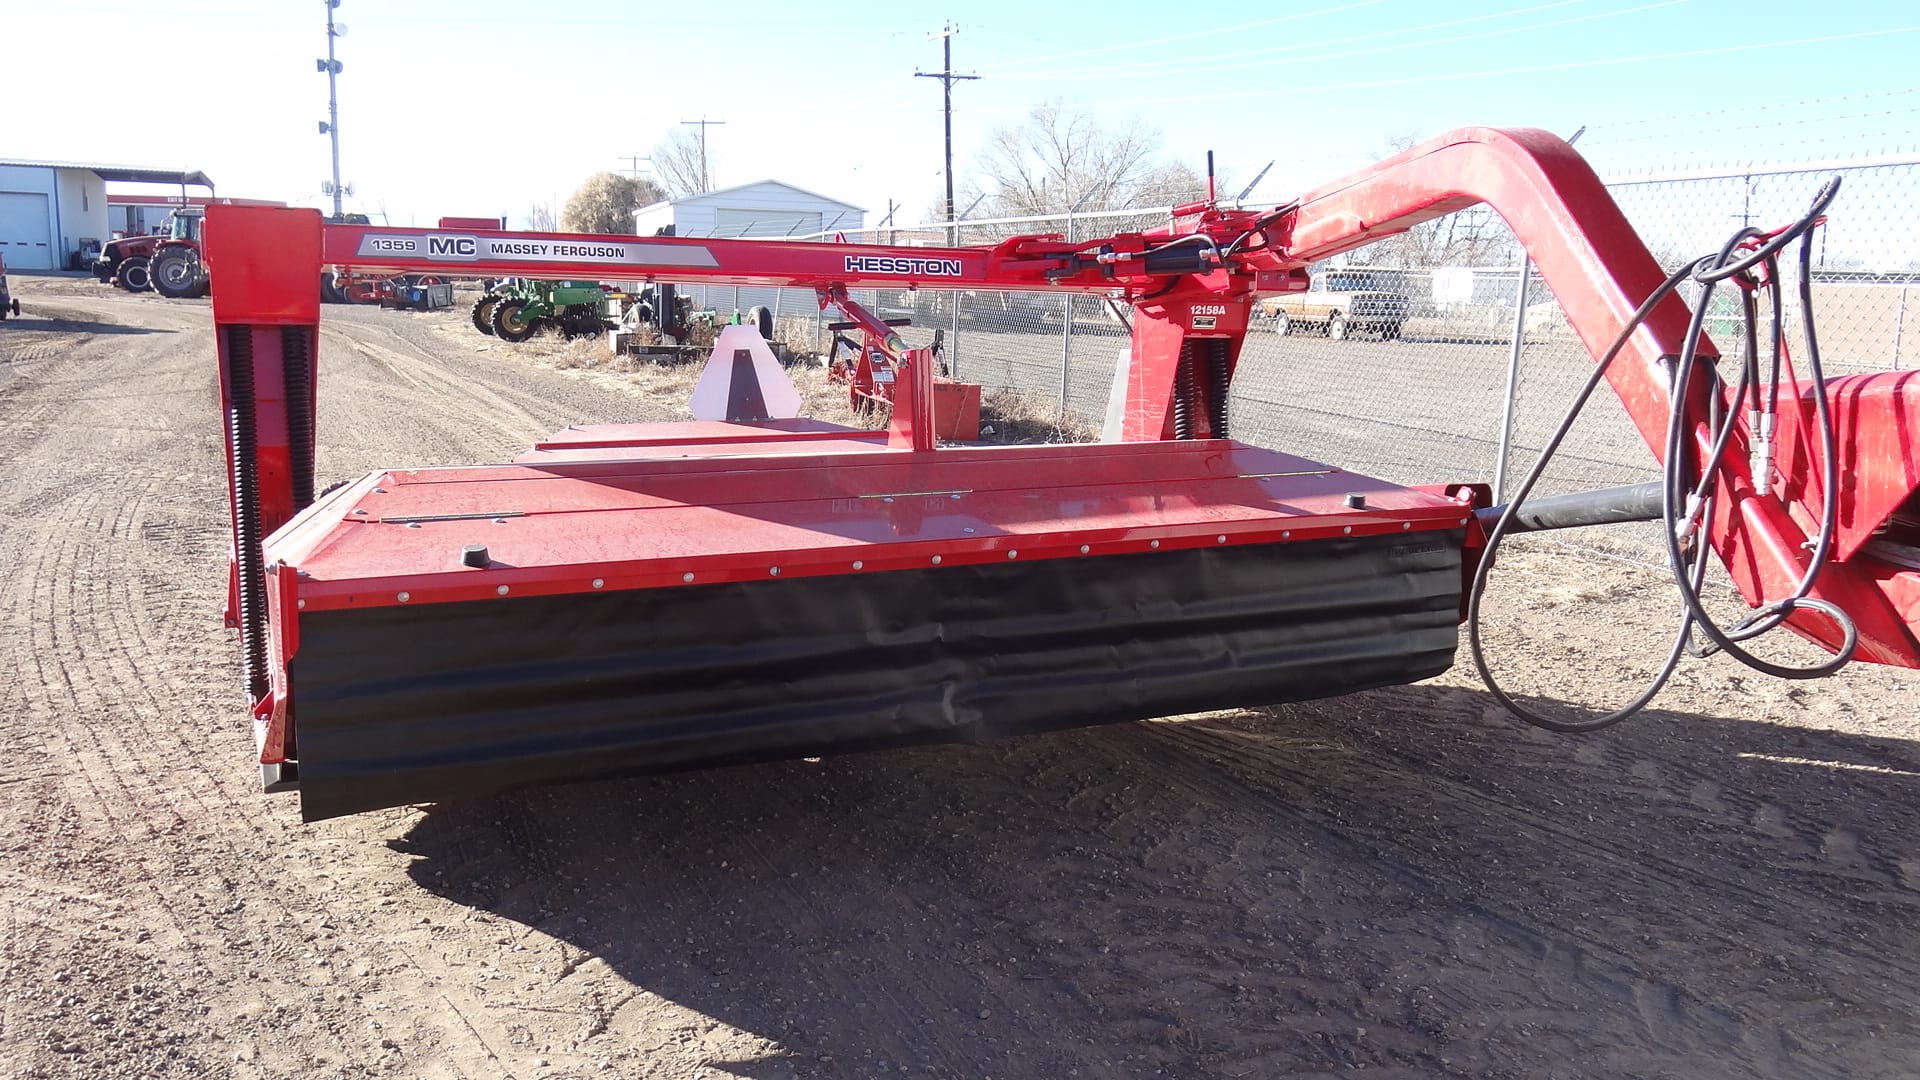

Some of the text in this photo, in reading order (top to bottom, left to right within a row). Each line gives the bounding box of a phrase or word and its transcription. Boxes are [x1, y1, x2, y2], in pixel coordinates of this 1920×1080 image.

[372, 237, 625, 258] 1359 MC MASSEY FERGUSON
[845, 256, 961, 275] HESSTON
